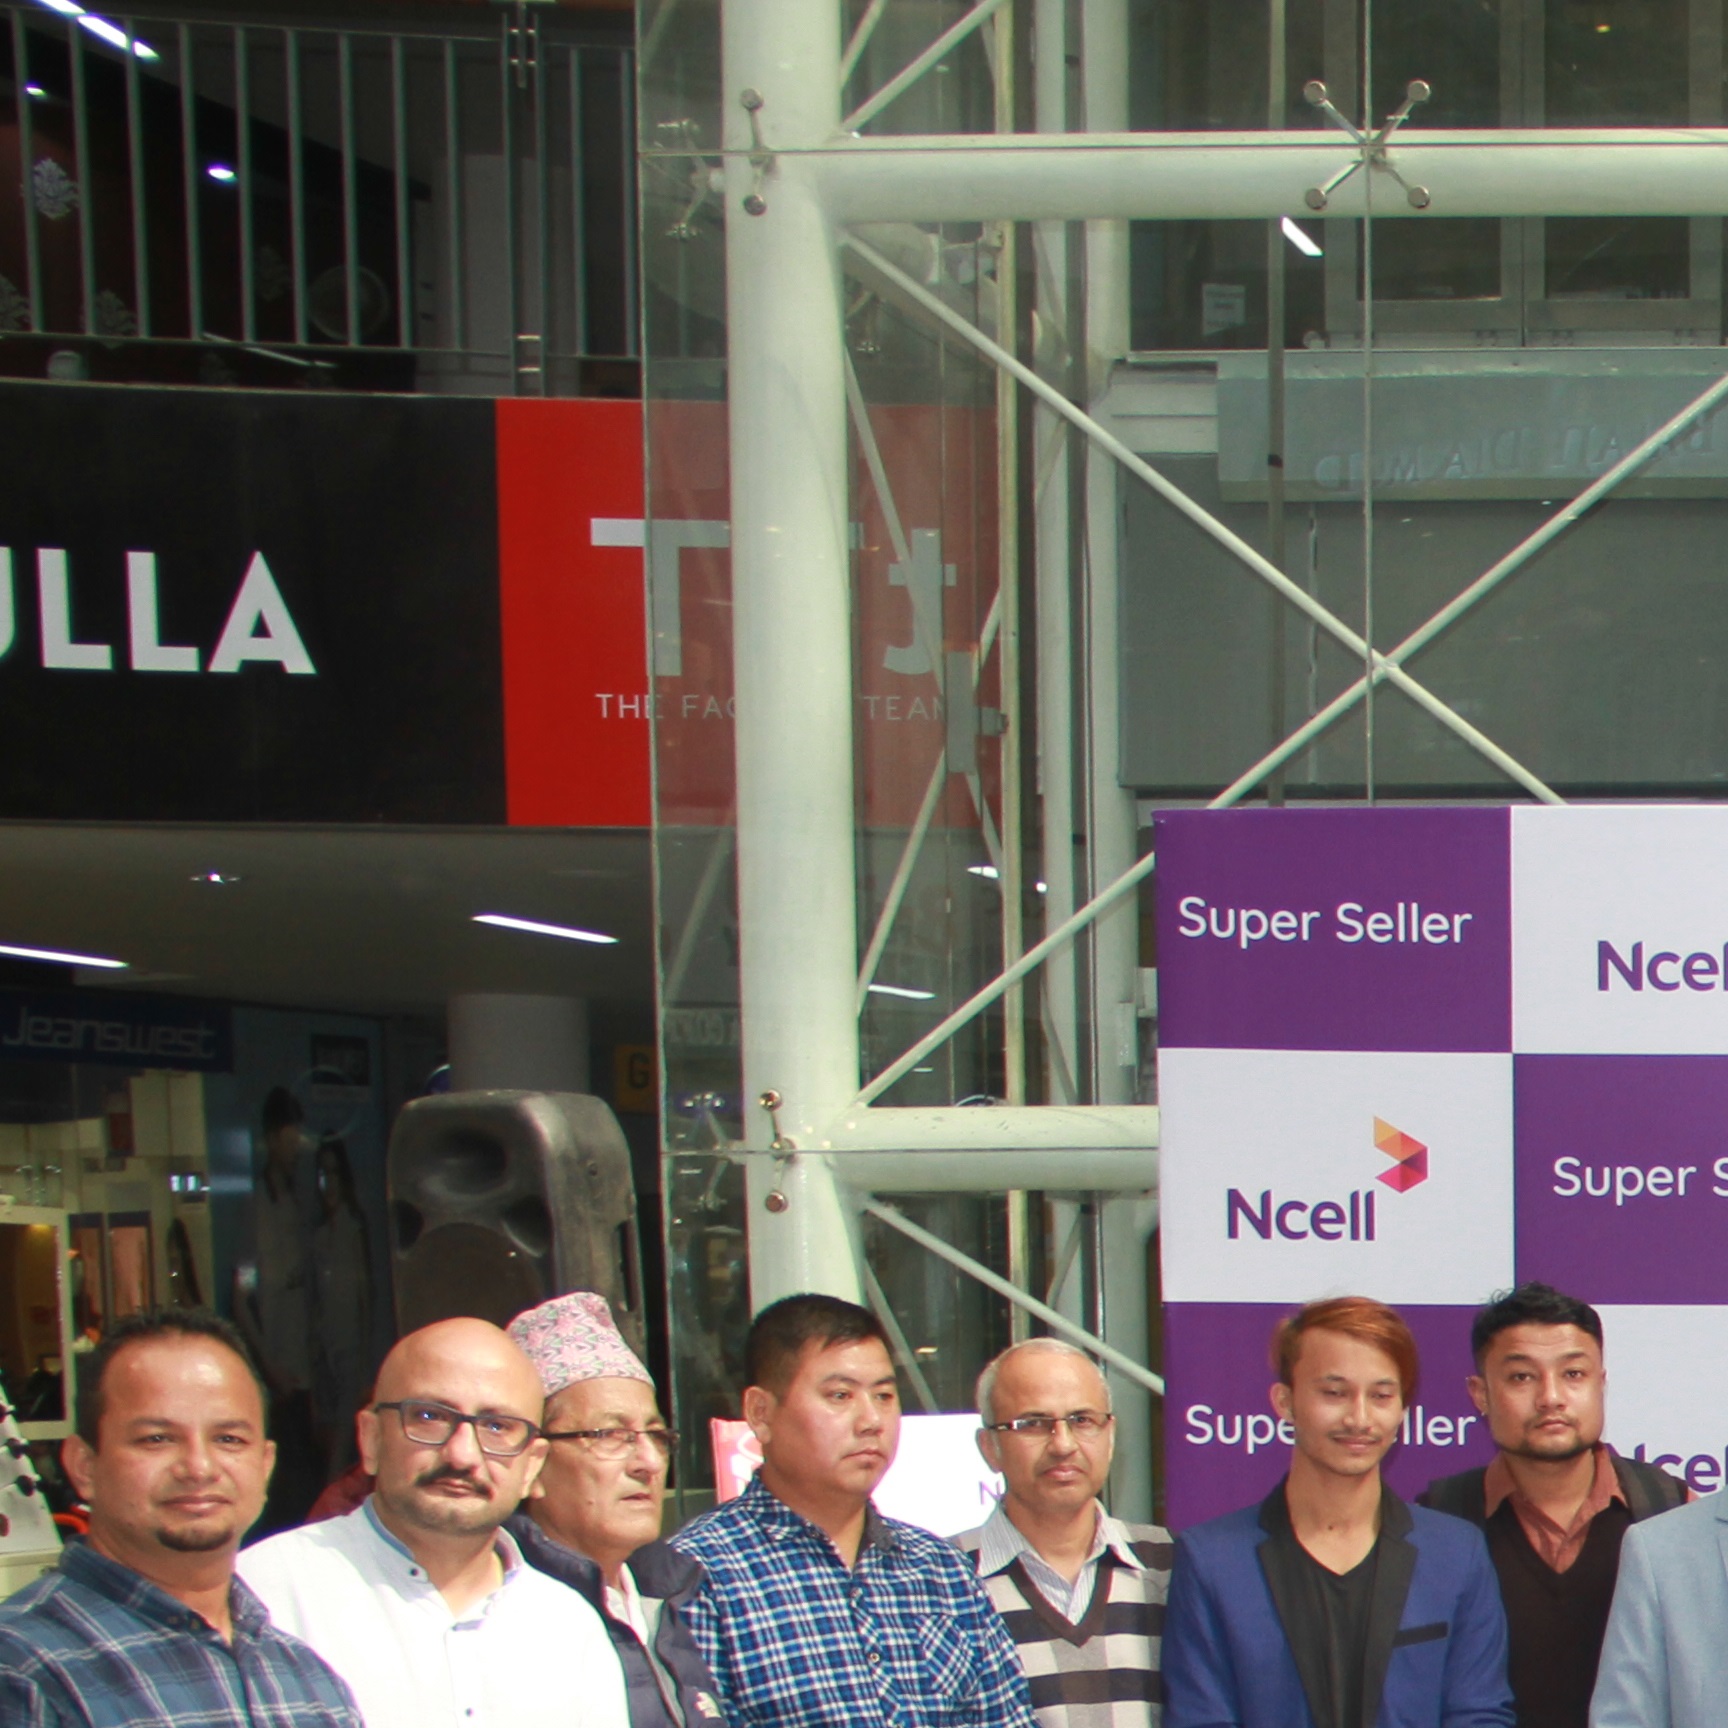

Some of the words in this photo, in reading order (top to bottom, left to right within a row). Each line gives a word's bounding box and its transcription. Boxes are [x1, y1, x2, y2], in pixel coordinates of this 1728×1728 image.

[0, 546, 317, 675] LLA
[595, 692, 664, 720] THE
[1178, 897, 1320, 950] Super
[1334, 901, 1473, 946] Seller
[2, 1006, 216, 1060] Jeanswest
[1551, 1156, 1698, 1206] Super
[1226, 1188, 1376, 1242] Ncell
[1186, 1405, 1297, 1455] Supe
